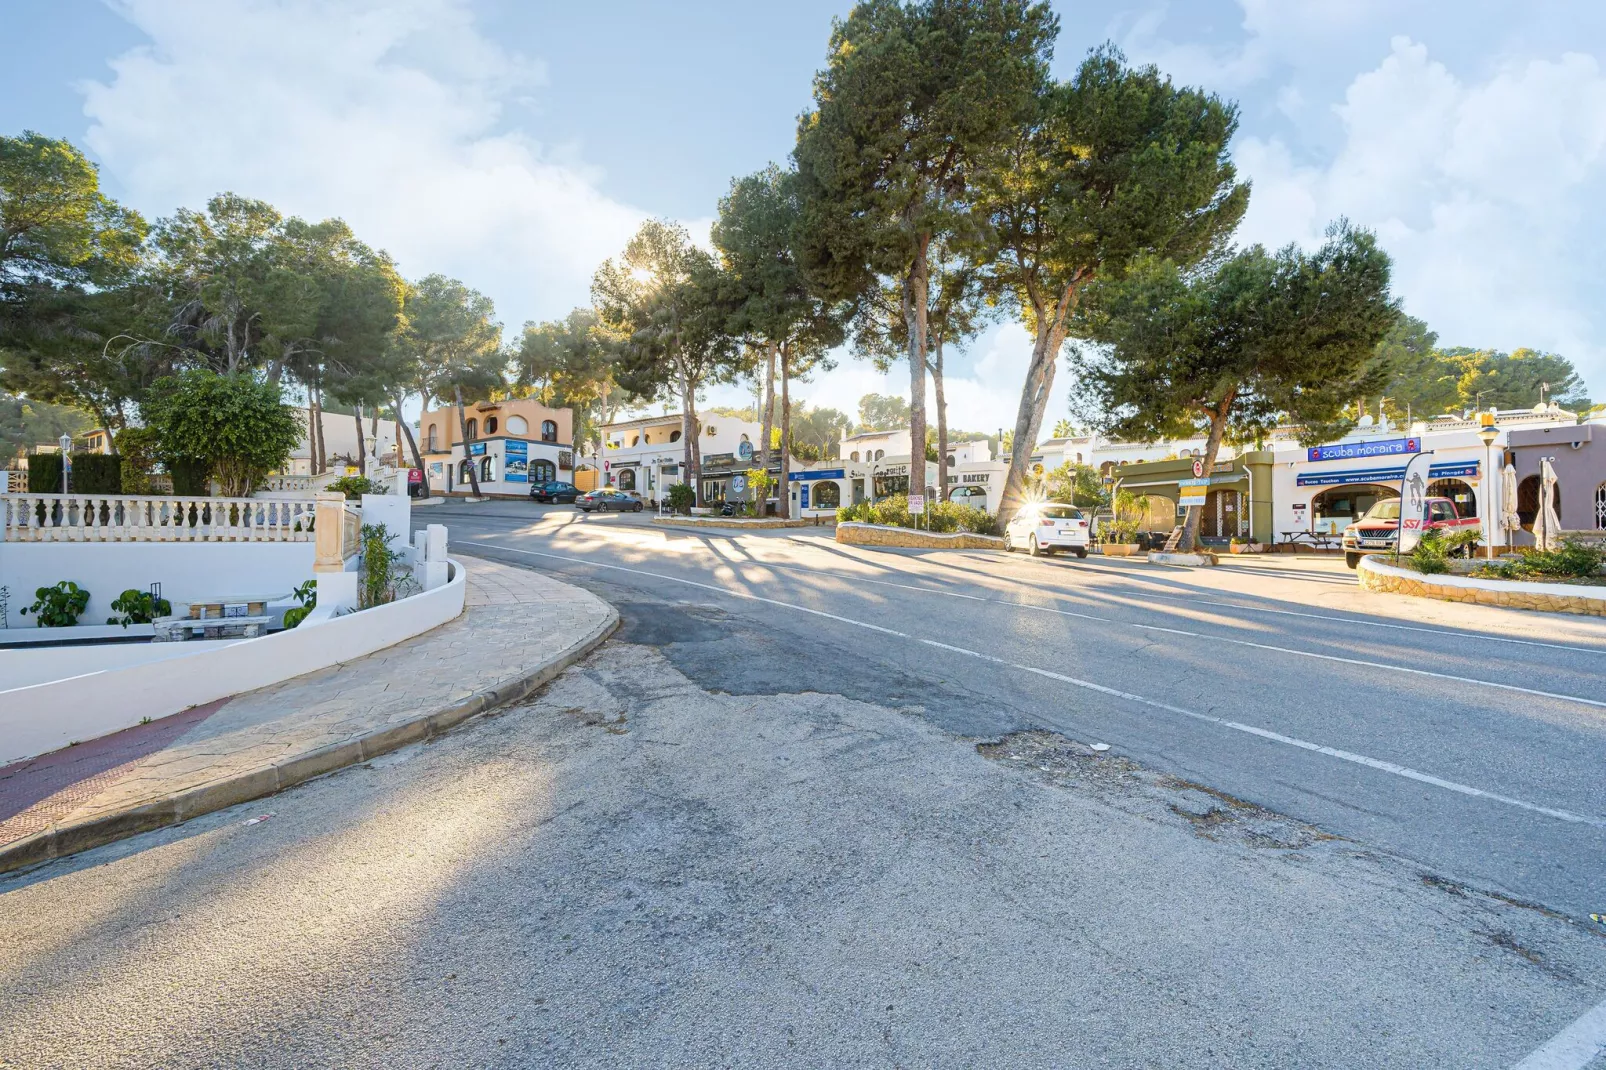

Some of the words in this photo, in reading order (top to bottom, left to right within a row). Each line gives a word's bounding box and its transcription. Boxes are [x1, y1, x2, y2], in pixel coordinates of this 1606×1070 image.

[1322, 445, 1354, 459] scuba
[1356, 443, 1403, 455] moraira
[962, 473, 990, 483] BAKERY
[1402, 519, 1421, 529] SSI
